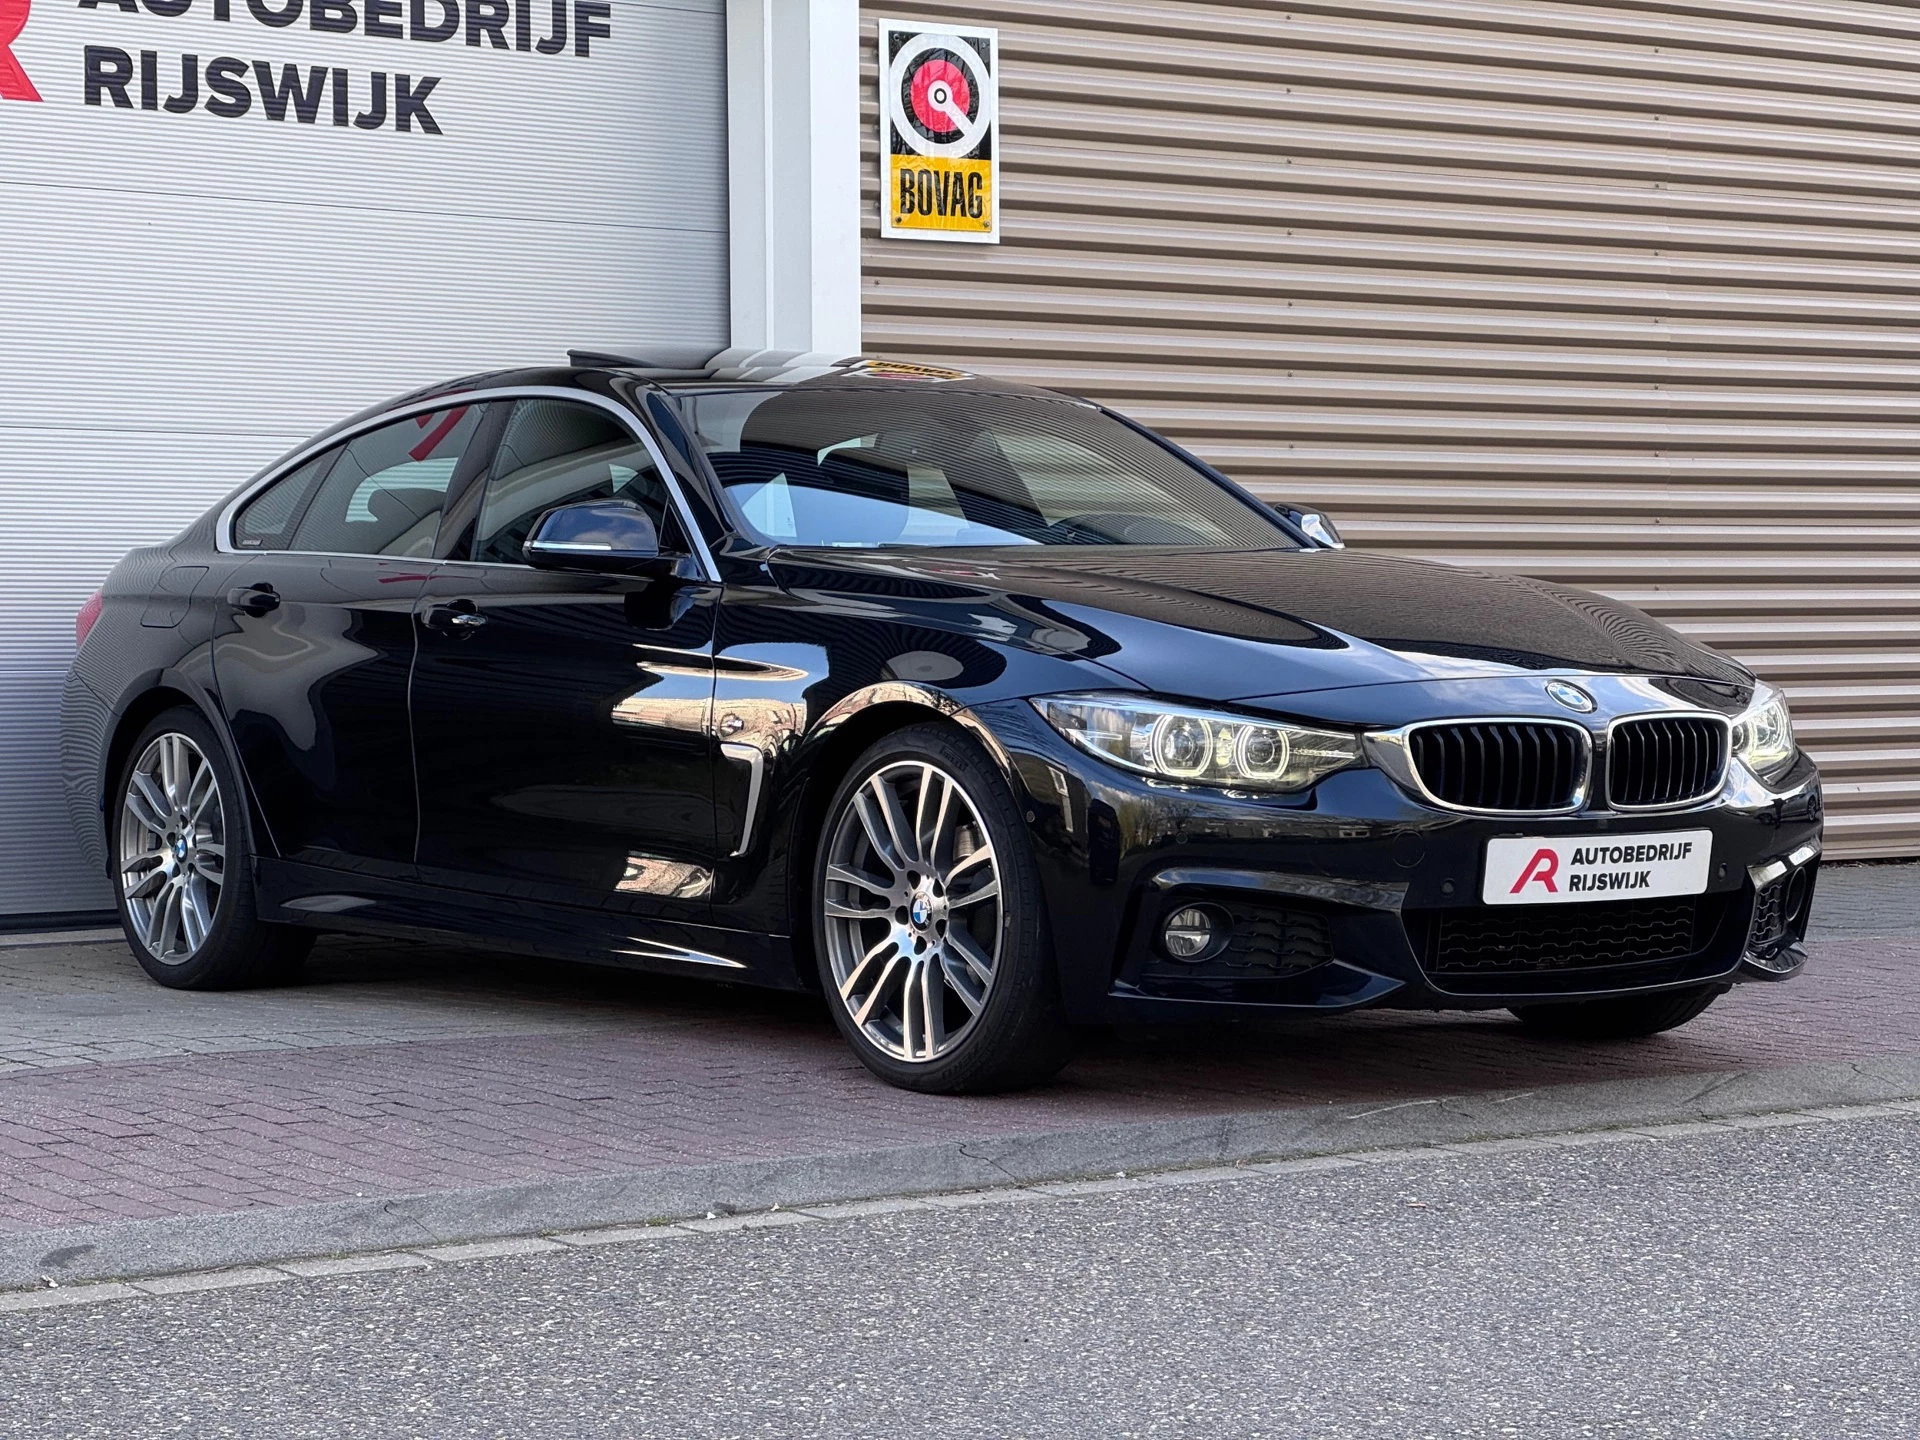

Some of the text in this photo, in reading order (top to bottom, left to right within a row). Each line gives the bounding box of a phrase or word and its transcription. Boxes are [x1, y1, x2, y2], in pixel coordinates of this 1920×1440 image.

[84, 45, 444, 135] RIJSWIJK
[900, 169, 983, 218] BOVAG
[1570, 842, 1693, 865] AUTOBEDRIJF
[1569, 871, 1651, 892] RIJSWIJK
